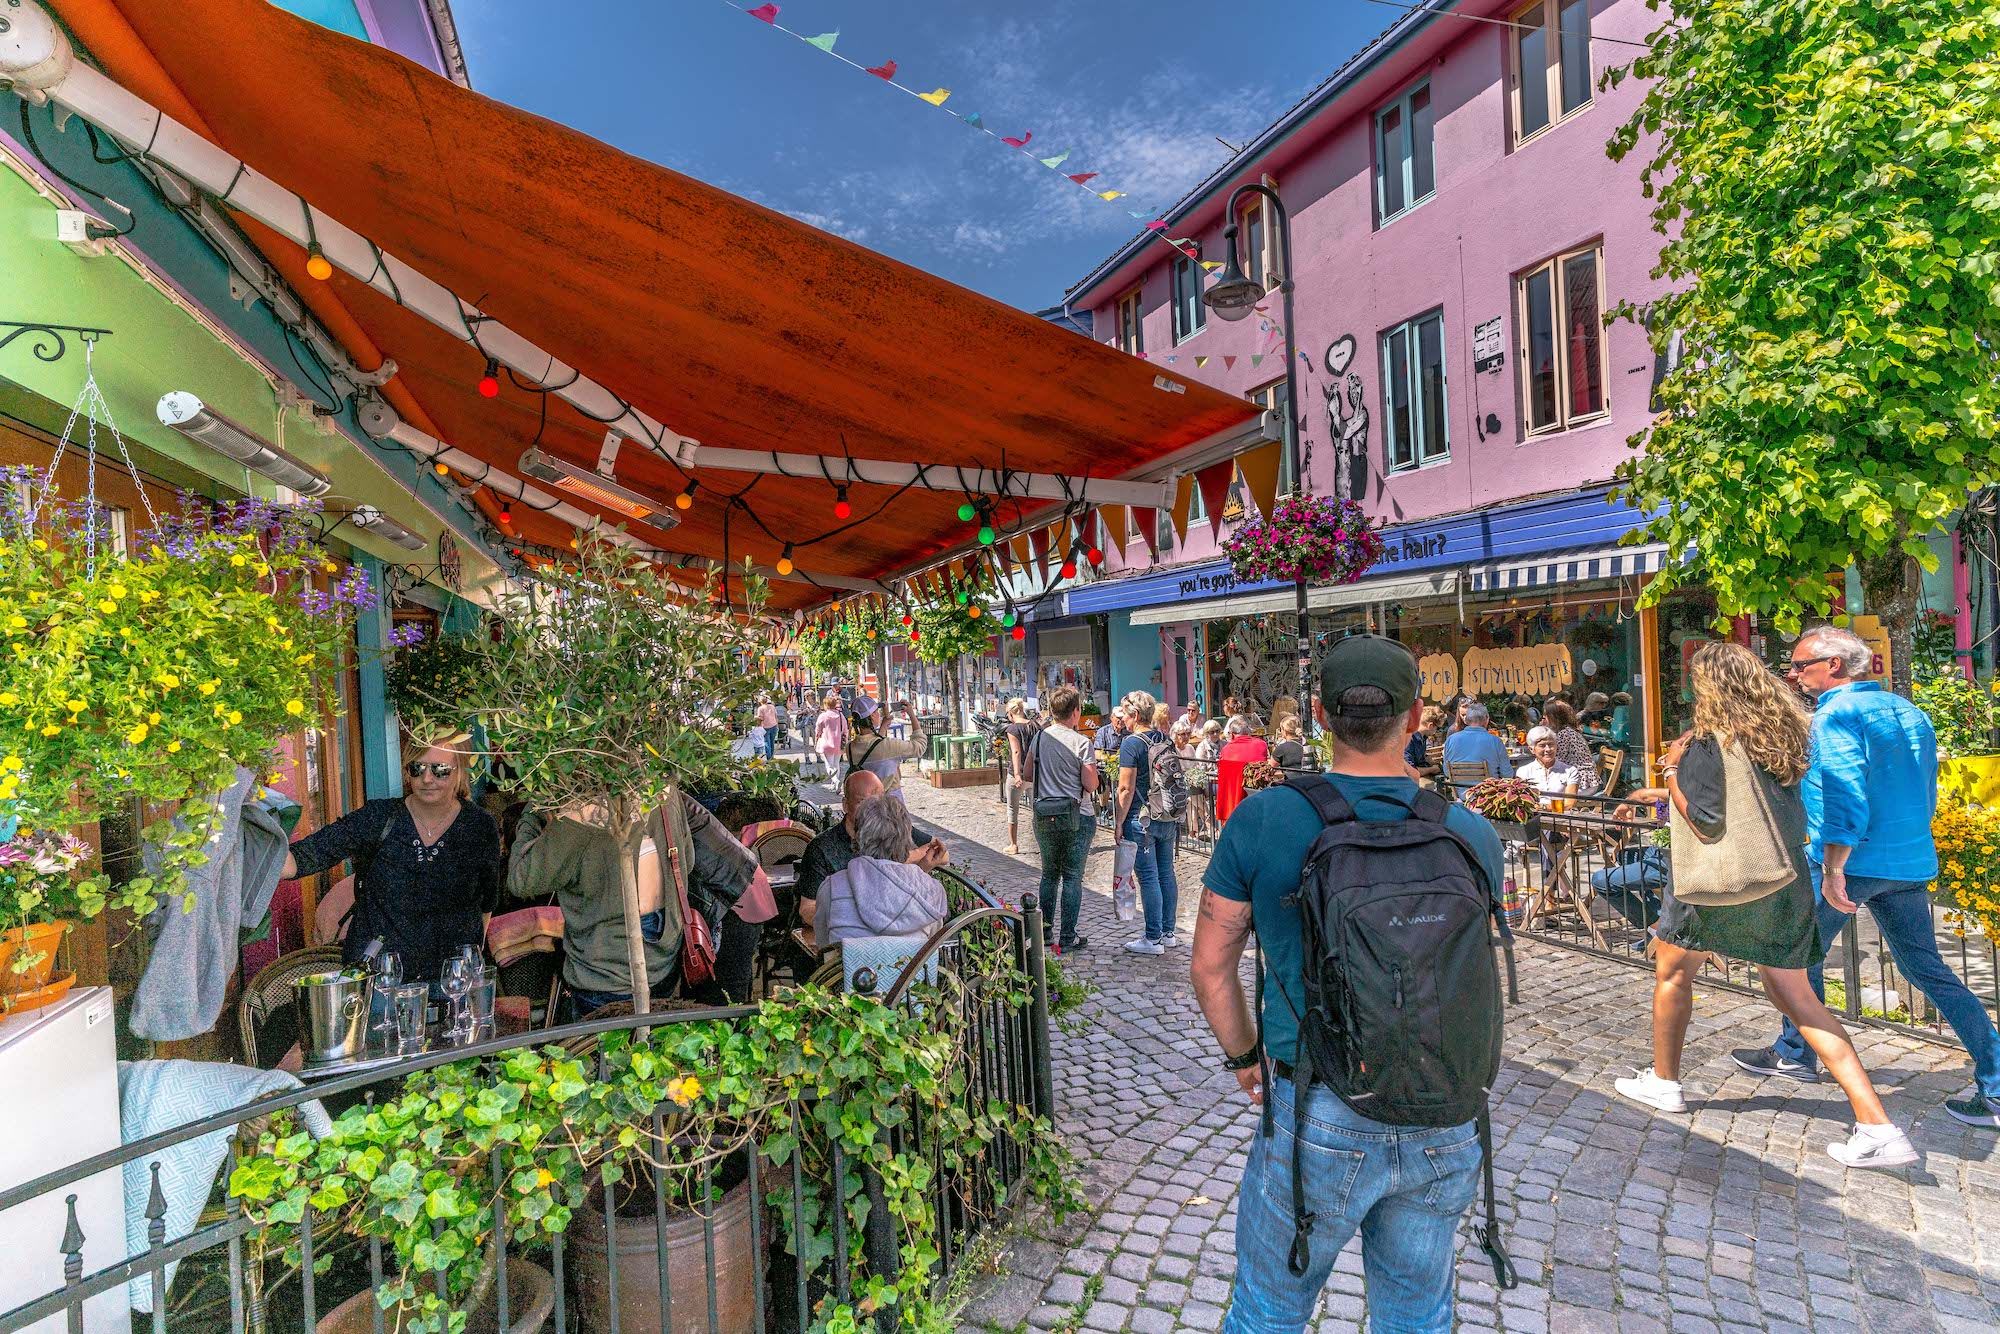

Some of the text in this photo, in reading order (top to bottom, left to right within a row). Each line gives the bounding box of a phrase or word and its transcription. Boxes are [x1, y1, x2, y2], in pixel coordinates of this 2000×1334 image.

[1178, 573, 1210, 597] you're
[1402, 533, 1447, 560] hair?
[1192, 627, 1204, 706] TATTOO
[1420, 660, 1570, 686] BOB STYLISTER
[1872, 654, 1884, 675] 6
[1406, 913, 1447, 925] VAUDE
